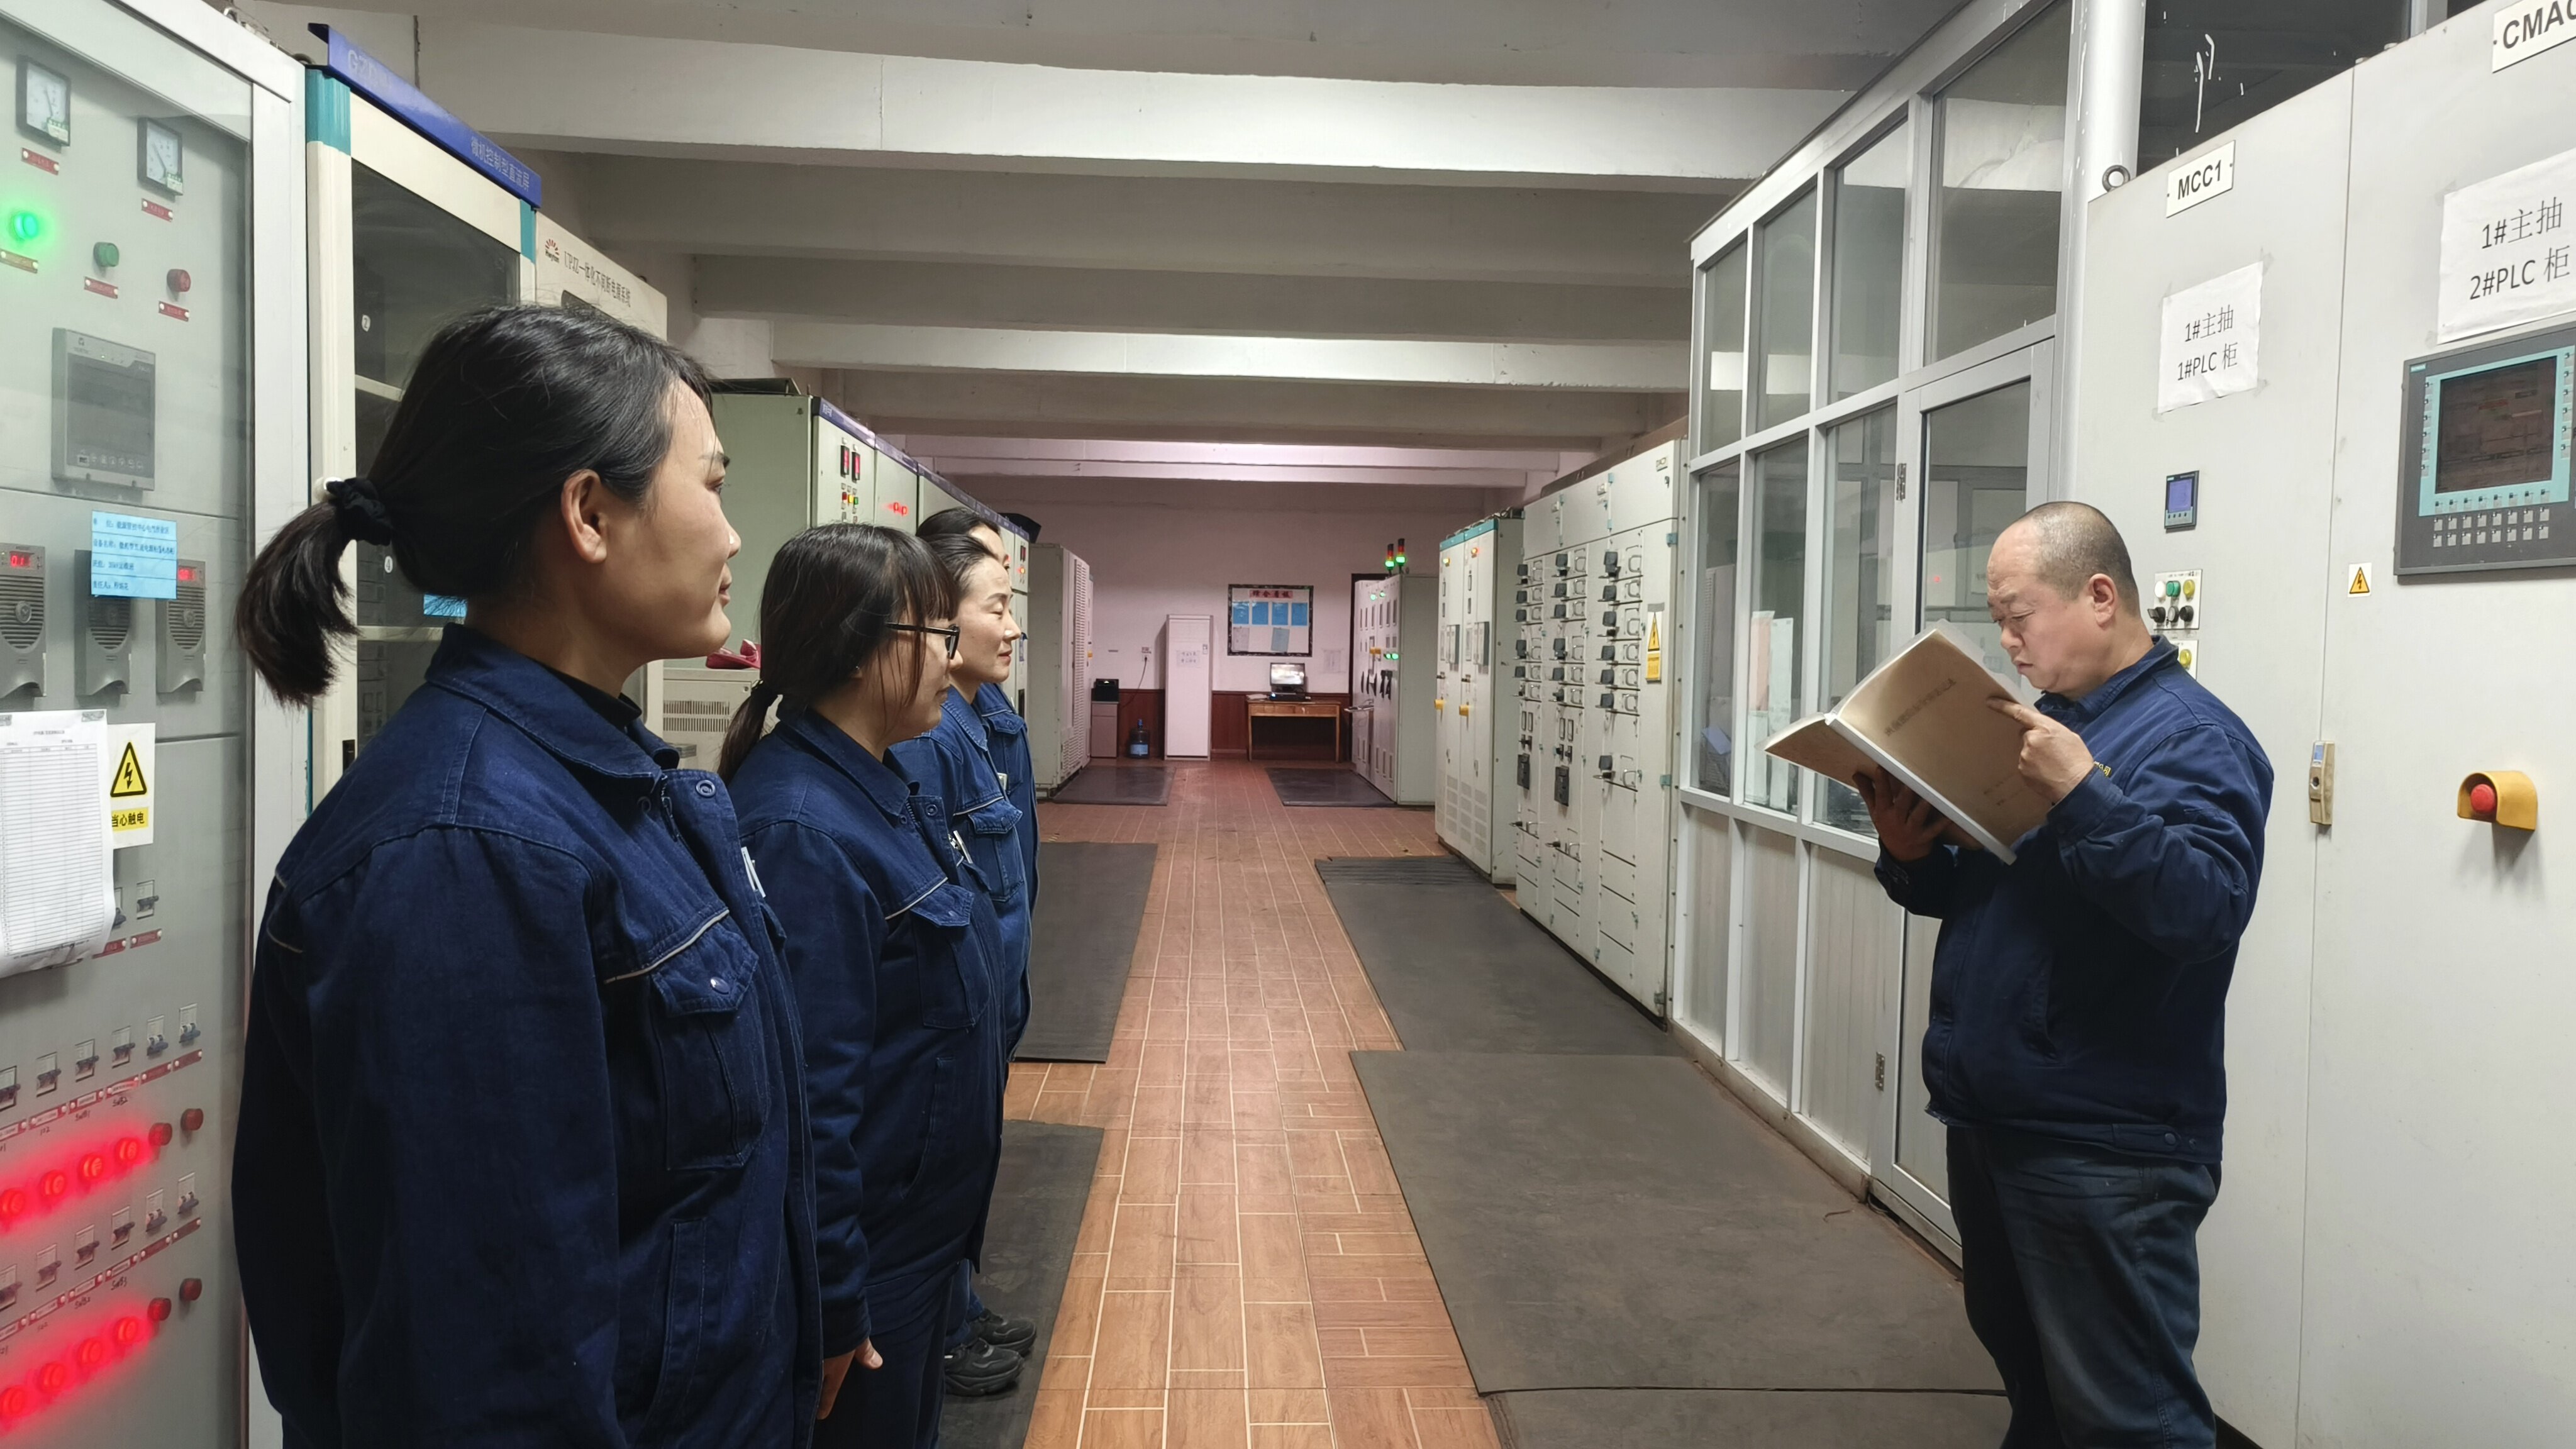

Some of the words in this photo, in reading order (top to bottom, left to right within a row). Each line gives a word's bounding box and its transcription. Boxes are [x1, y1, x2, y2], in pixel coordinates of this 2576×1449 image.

[2178, 160, 2221, 199] MCC1
[2482, 197, 2562, 249] 1#主抽
[2470, 260, 2536, 300] 2#PLC
[2543, 245, 2570, 282] 柜
[2185, 304, 2233, 342] 1#主抽
[2177, 352, 2217, 380] 1#PLC
[2222, 342, 2238, 370] 柜
[111, 811, 145, 827] 当心触电
